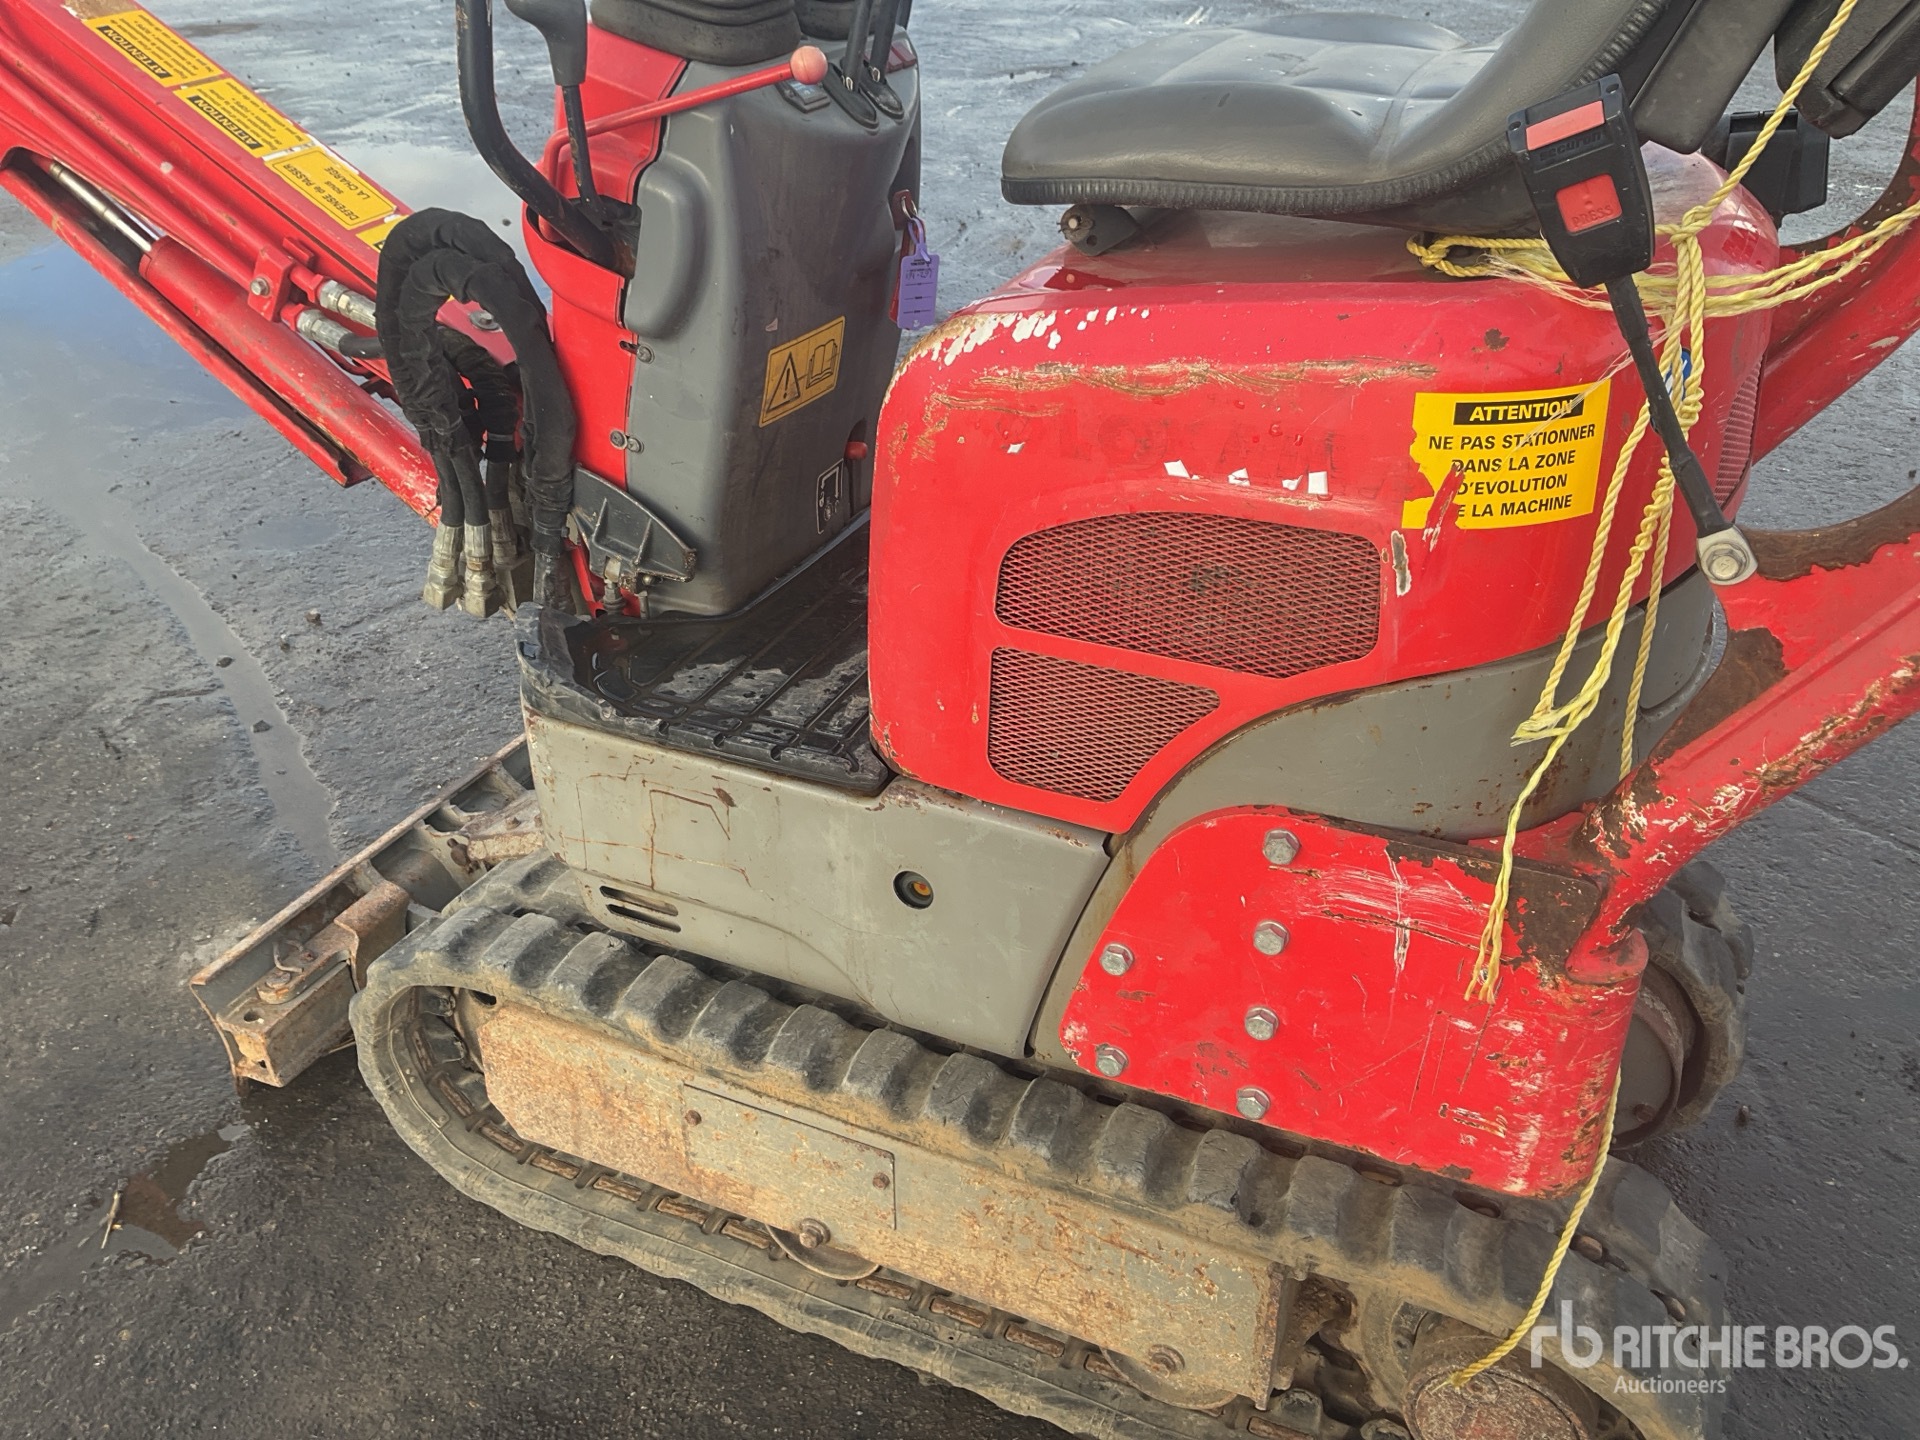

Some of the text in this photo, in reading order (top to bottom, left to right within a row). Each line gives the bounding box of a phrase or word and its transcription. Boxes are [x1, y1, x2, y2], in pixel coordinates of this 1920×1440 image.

[104, 28, 168, 75] ATTENTION
[195, 100, 257, 144] ATTENTION
[283, 164, 316, 187] PASSER
[324, 166, 360, 192] CHARGE
[323, 193, 360, 221] DEFENSE
[1573, 206, 1613, 227] PRESS
[1469, 399, 1573, 422] ATTENTION
[1429, 424, 1596, 450] NE PAS STATIONNER
[1452, 450, 1576, 473] DANS LA ZONE
[1471, 504, 1494, 517] LA
[1500, 494, 1573, 517] MACHINE
